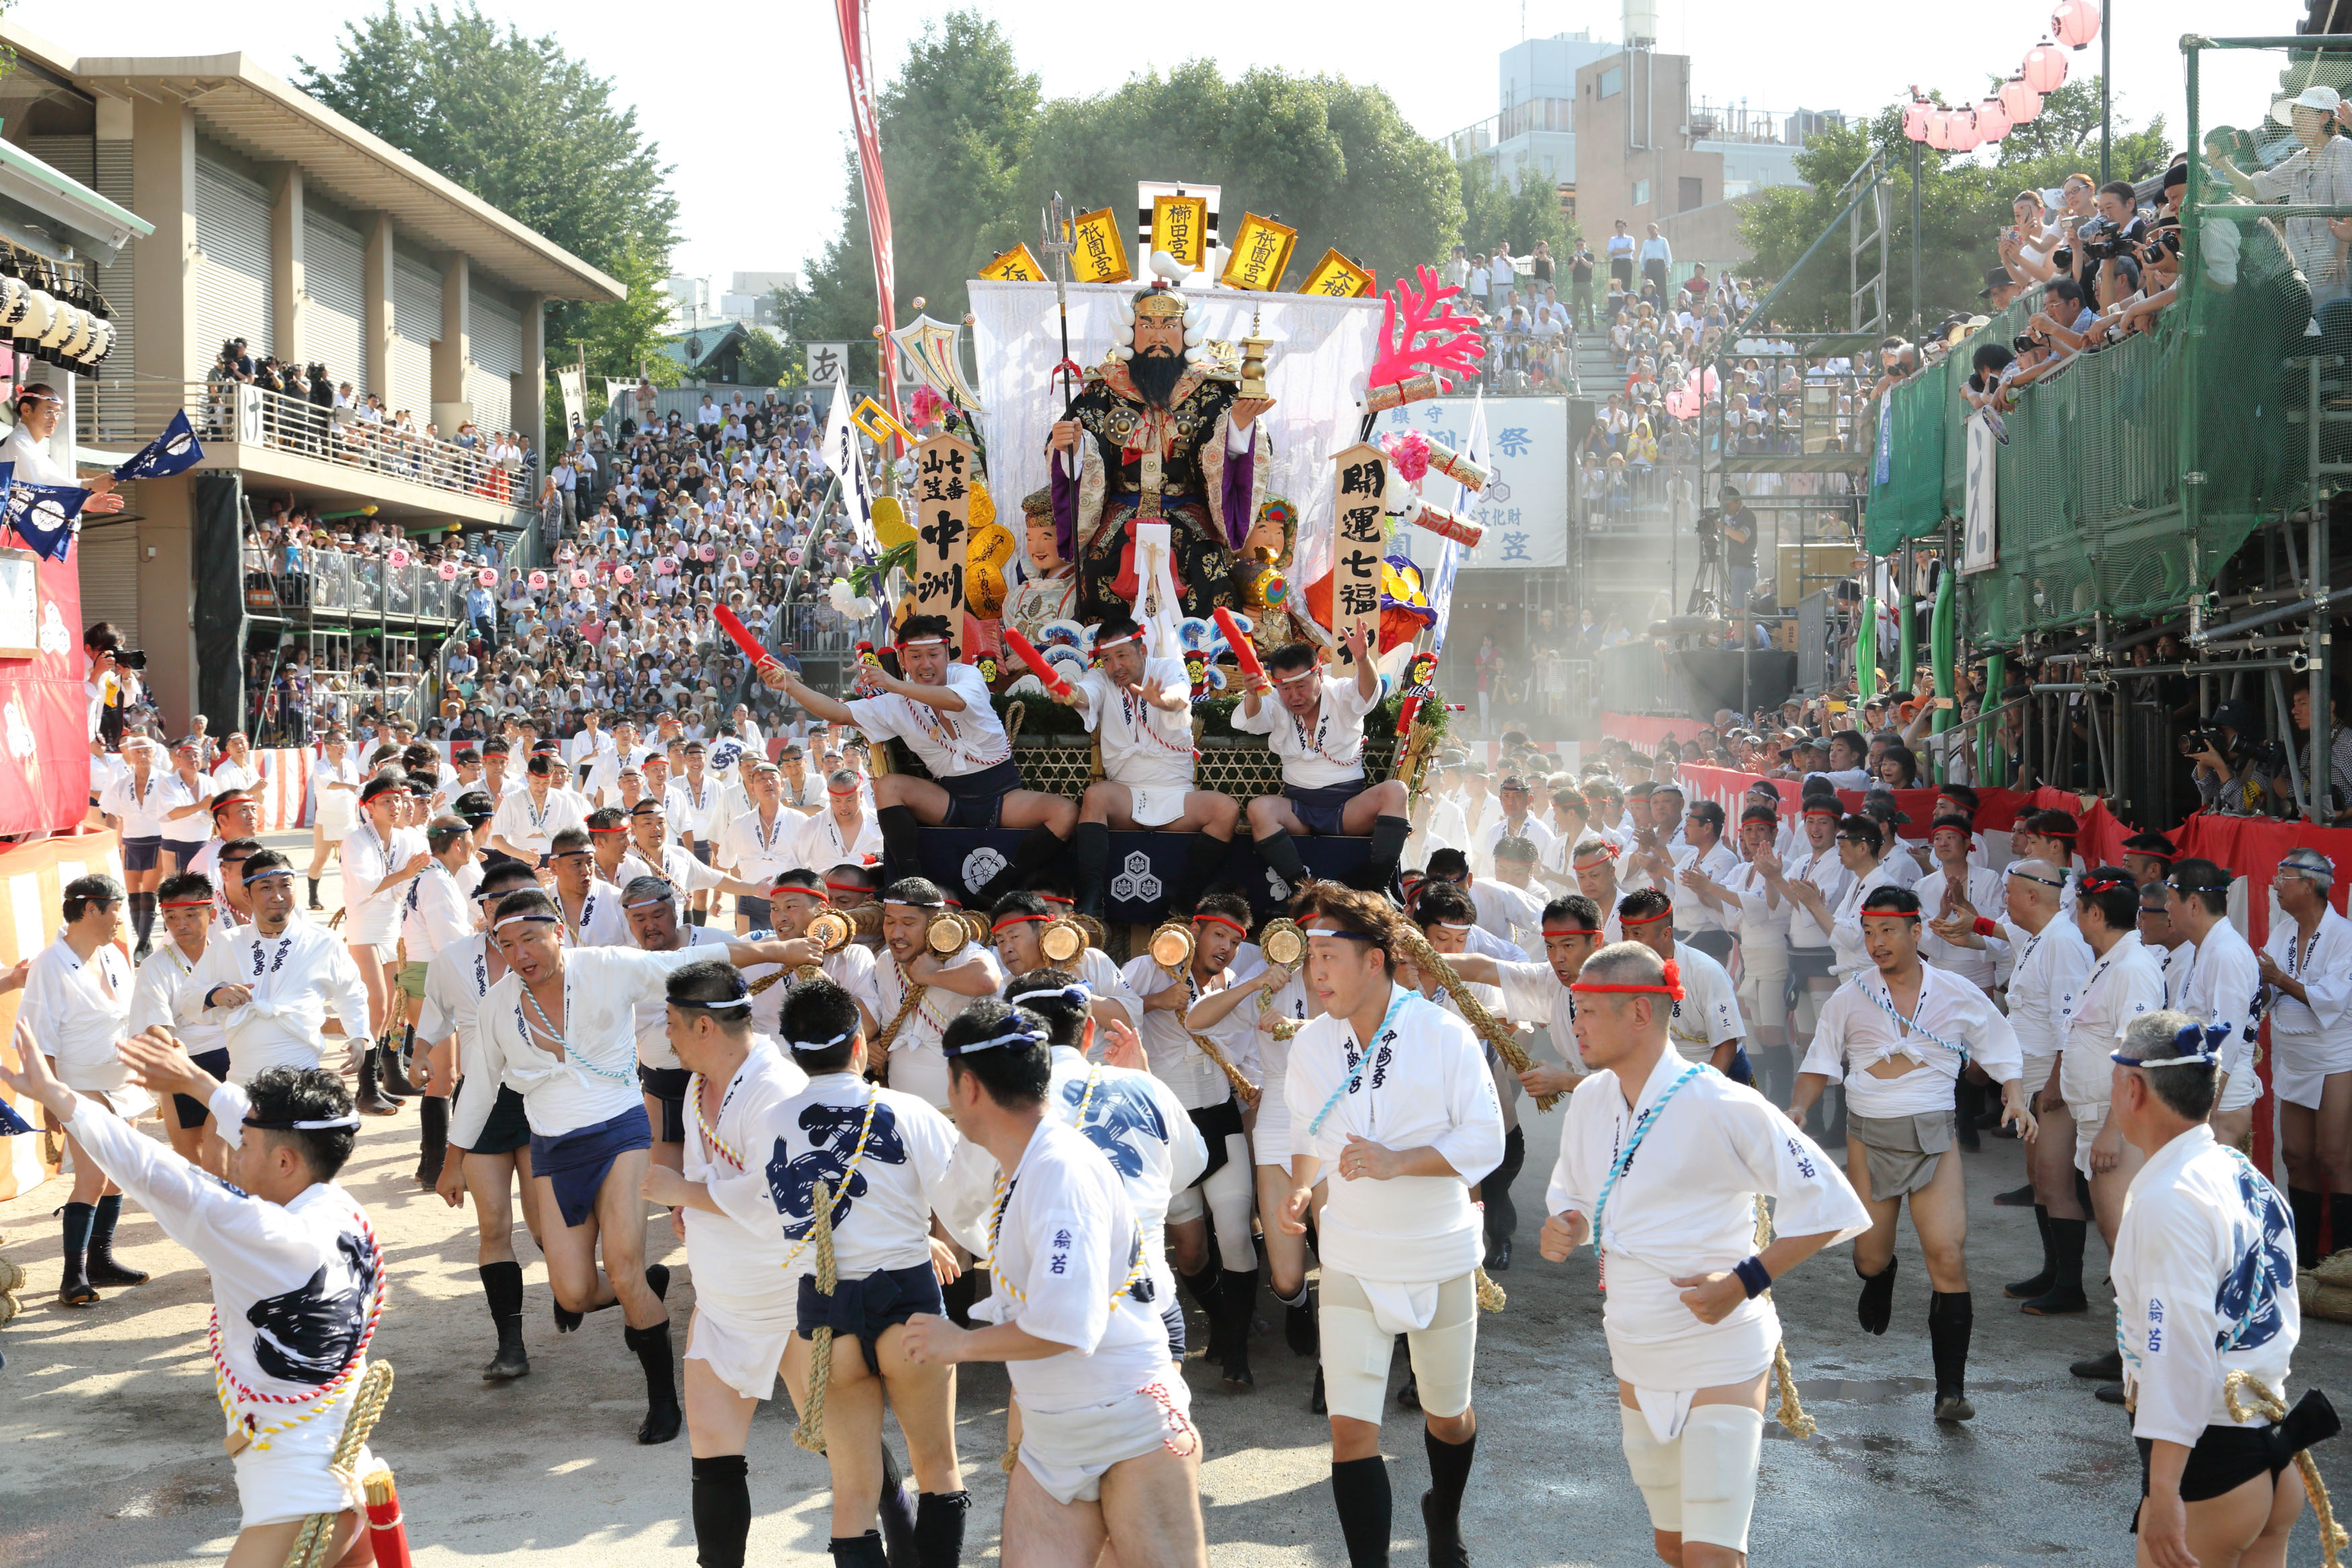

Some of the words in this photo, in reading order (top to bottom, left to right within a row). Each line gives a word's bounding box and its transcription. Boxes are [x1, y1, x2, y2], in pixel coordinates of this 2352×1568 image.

[1078, 222, 1113, 277] 祇園宮
[1166, 204, 1192, 260] 櫛田宮
[1243, 228, 1276, 284] 祇園宮
[812, 347, 845, 383] あ
[921, 449, 948, 503] 山笠
[945, 449, 969, 500] 七番
[1719, 1004, 1731, 1027] 中三
